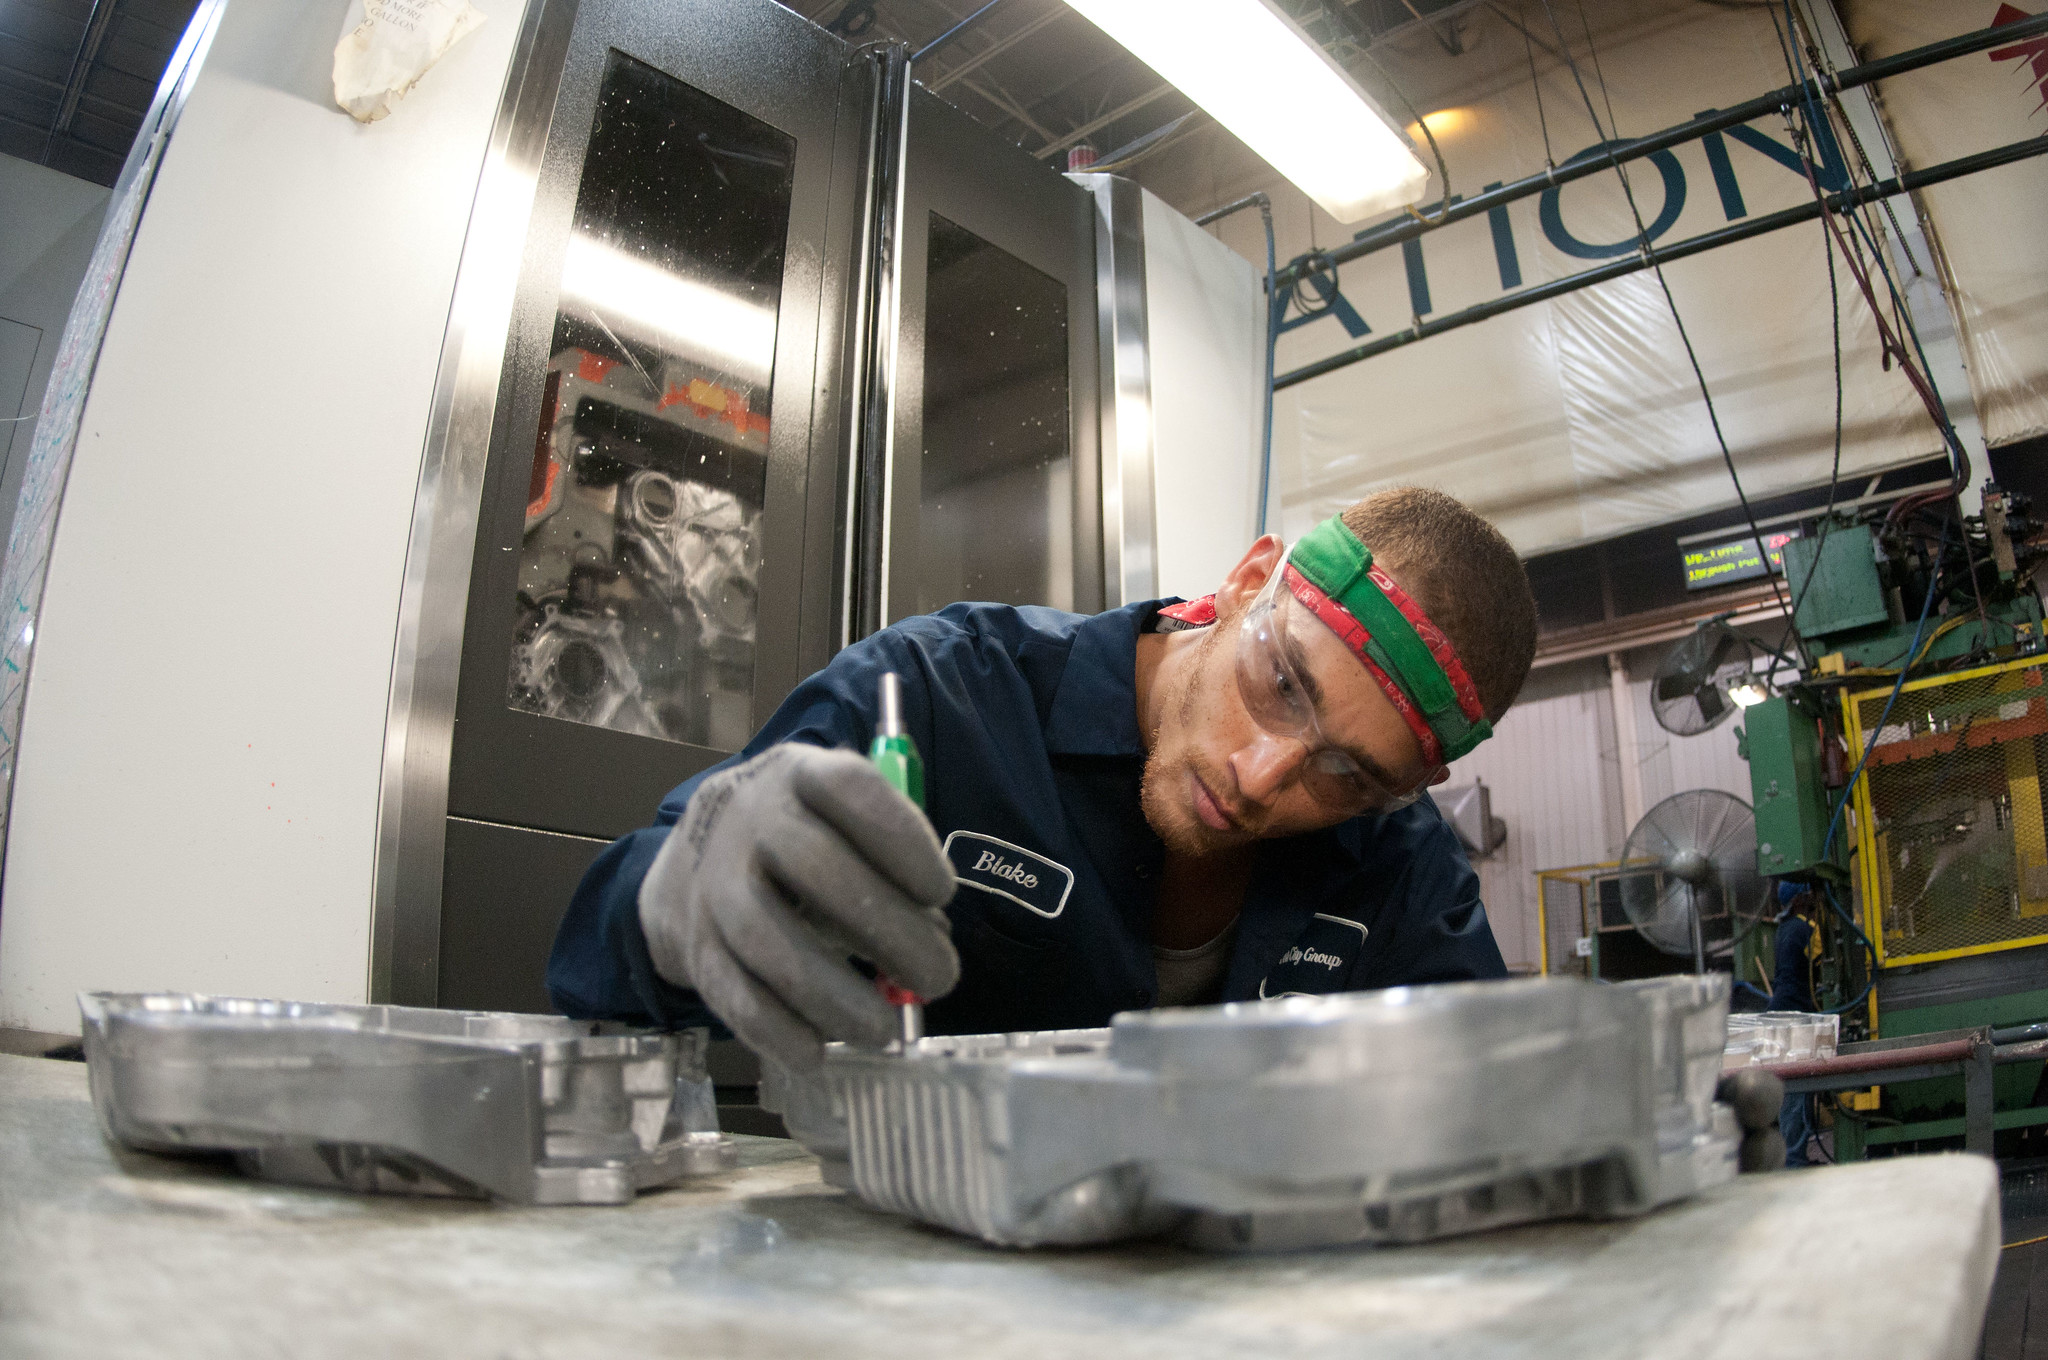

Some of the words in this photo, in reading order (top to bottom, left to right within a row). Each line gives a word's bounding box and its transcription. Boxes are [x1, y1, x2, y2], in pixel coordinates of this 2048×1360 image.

[370, 7, 416, 31] GALLON
[393, 2, 423, 20] MORE
[972, 850, 1038, 888] Blake
[1303, 947, 1343, 970] Group
